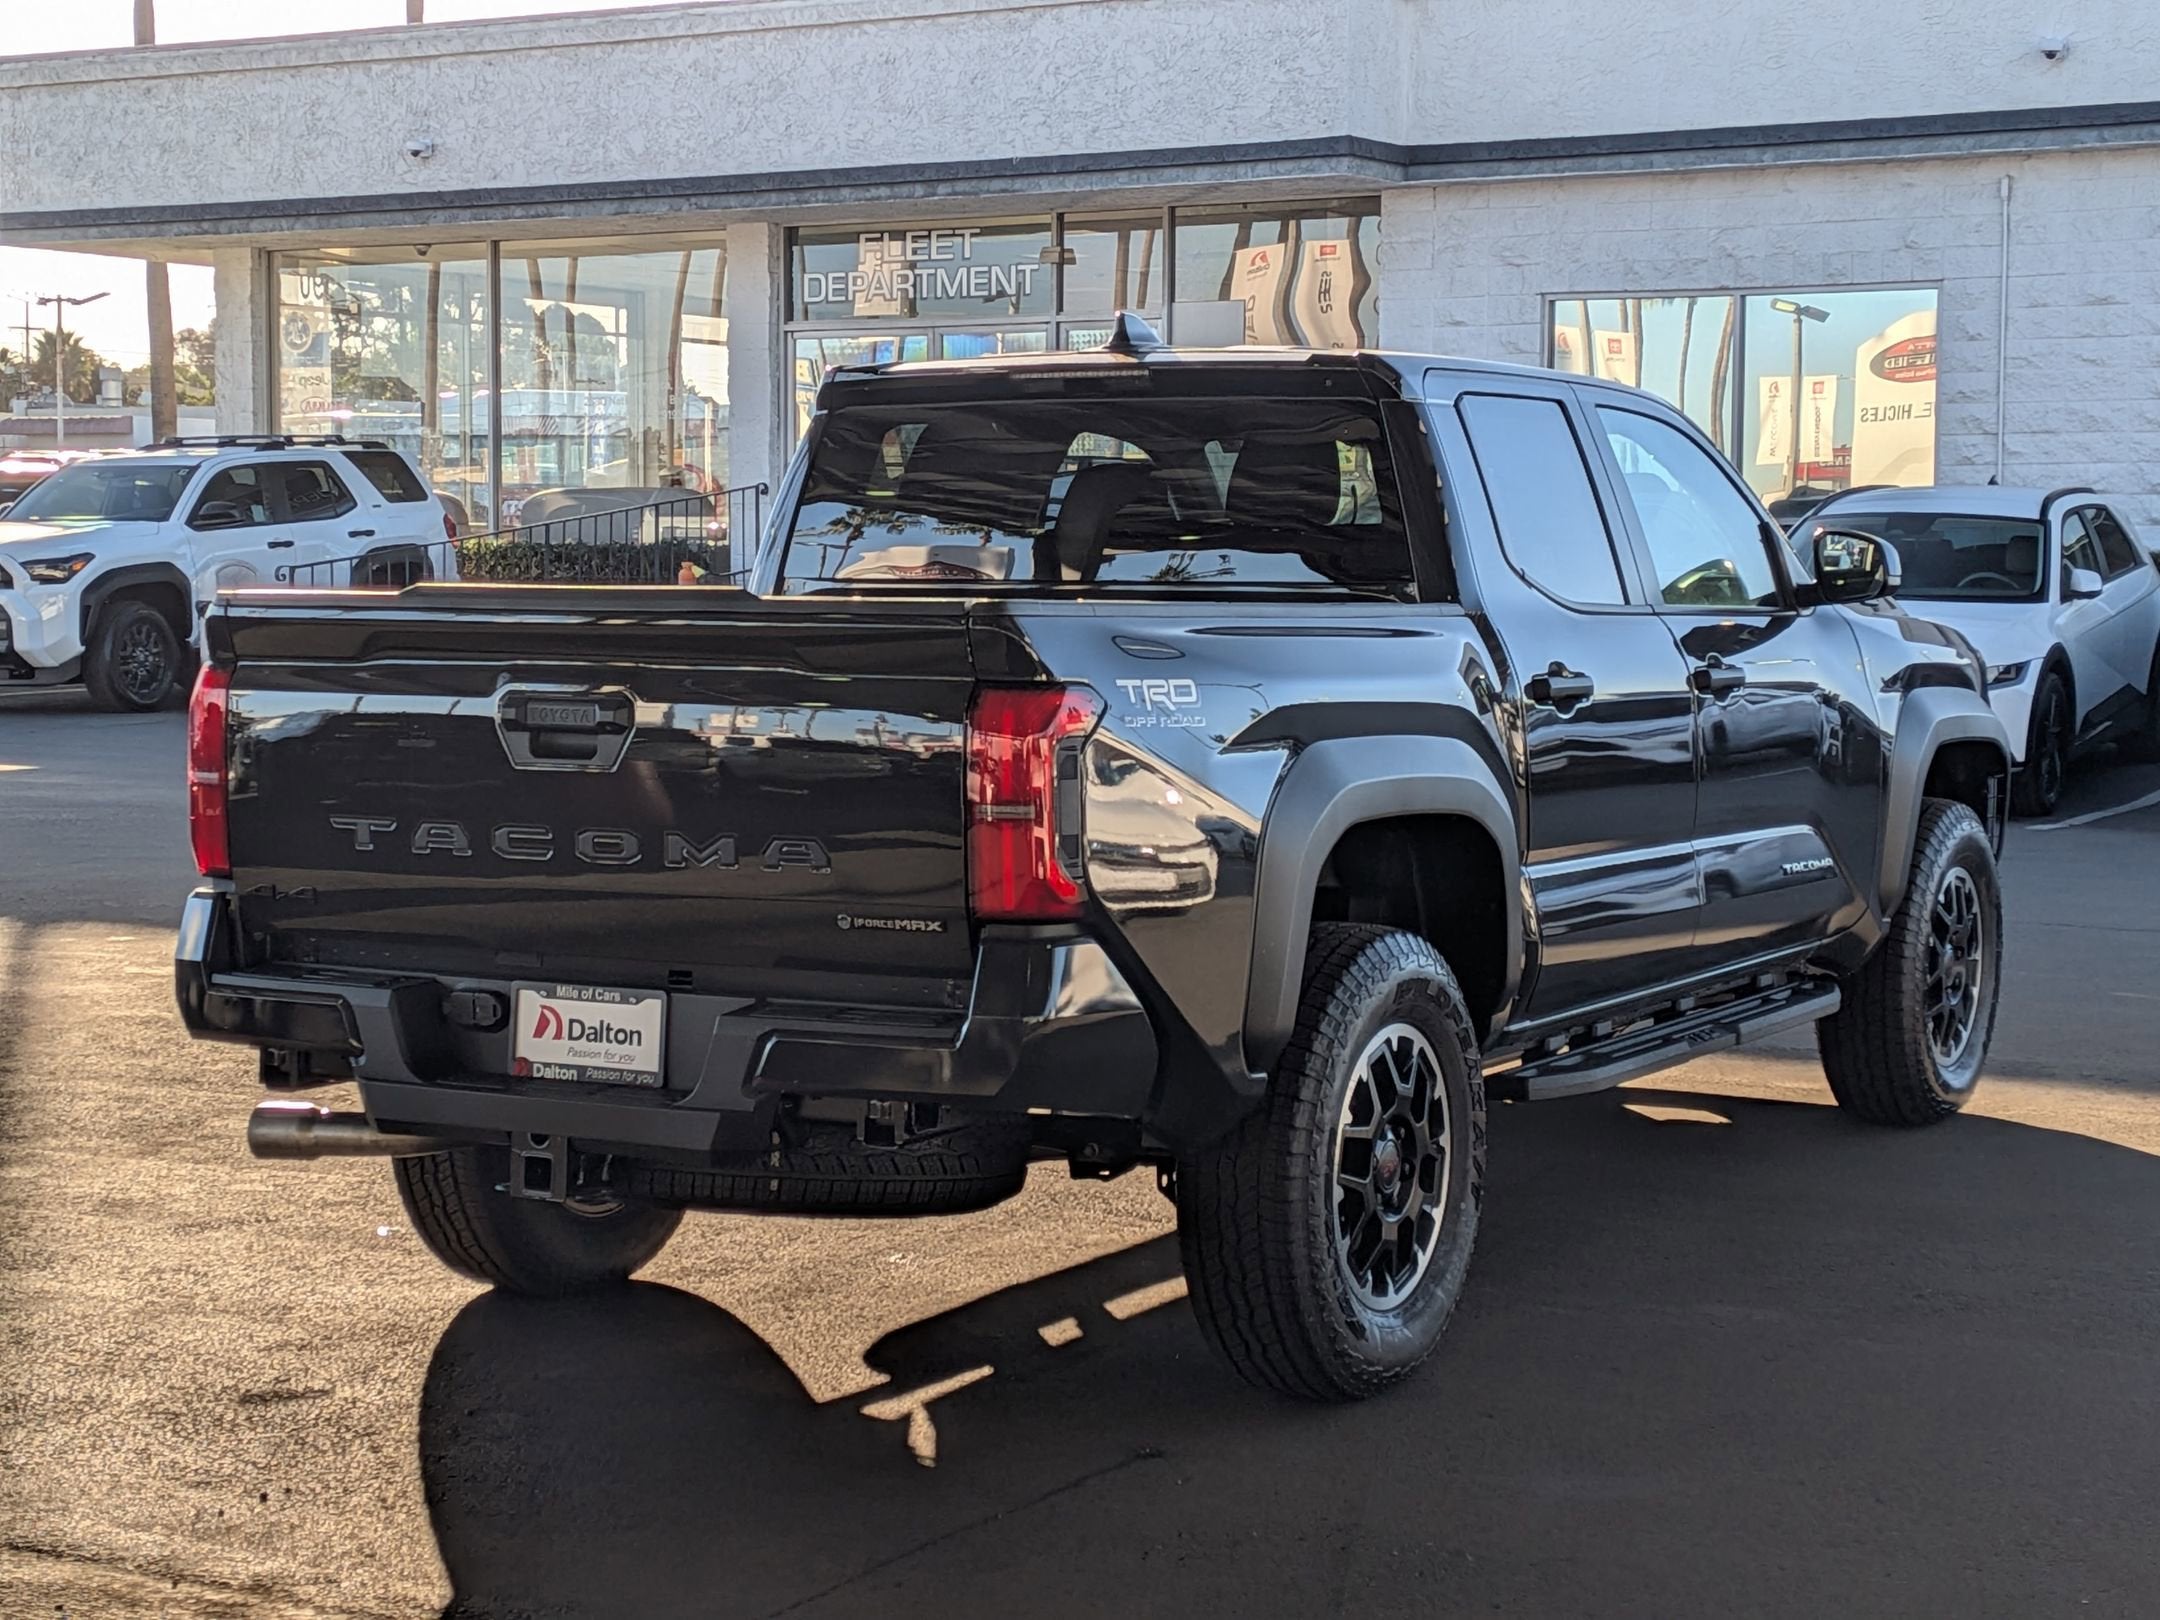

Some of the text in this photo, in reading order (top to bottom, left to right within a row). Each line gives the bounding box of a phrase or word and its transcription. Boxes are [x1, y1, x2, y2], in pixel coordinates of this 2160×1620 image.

[858, 228, 981, 263] FLEET
[803, 263, 1039, 304] DEPARTMENT
[1115, 678, 1198, 711] TRD
[527, 706, 592, 725] TOYOTA
[329, 813, 832, 874] TACOMA
[1781, 857, 1834, 874] TACOMA
[556, 984, 622, 1003] Mile of Cars
[567, 1018, 643, 1047] Dalton
[566, 1046, 636, 1064] Passion for you
[532, 1064, 656, 1085] Dalton Passion for you
